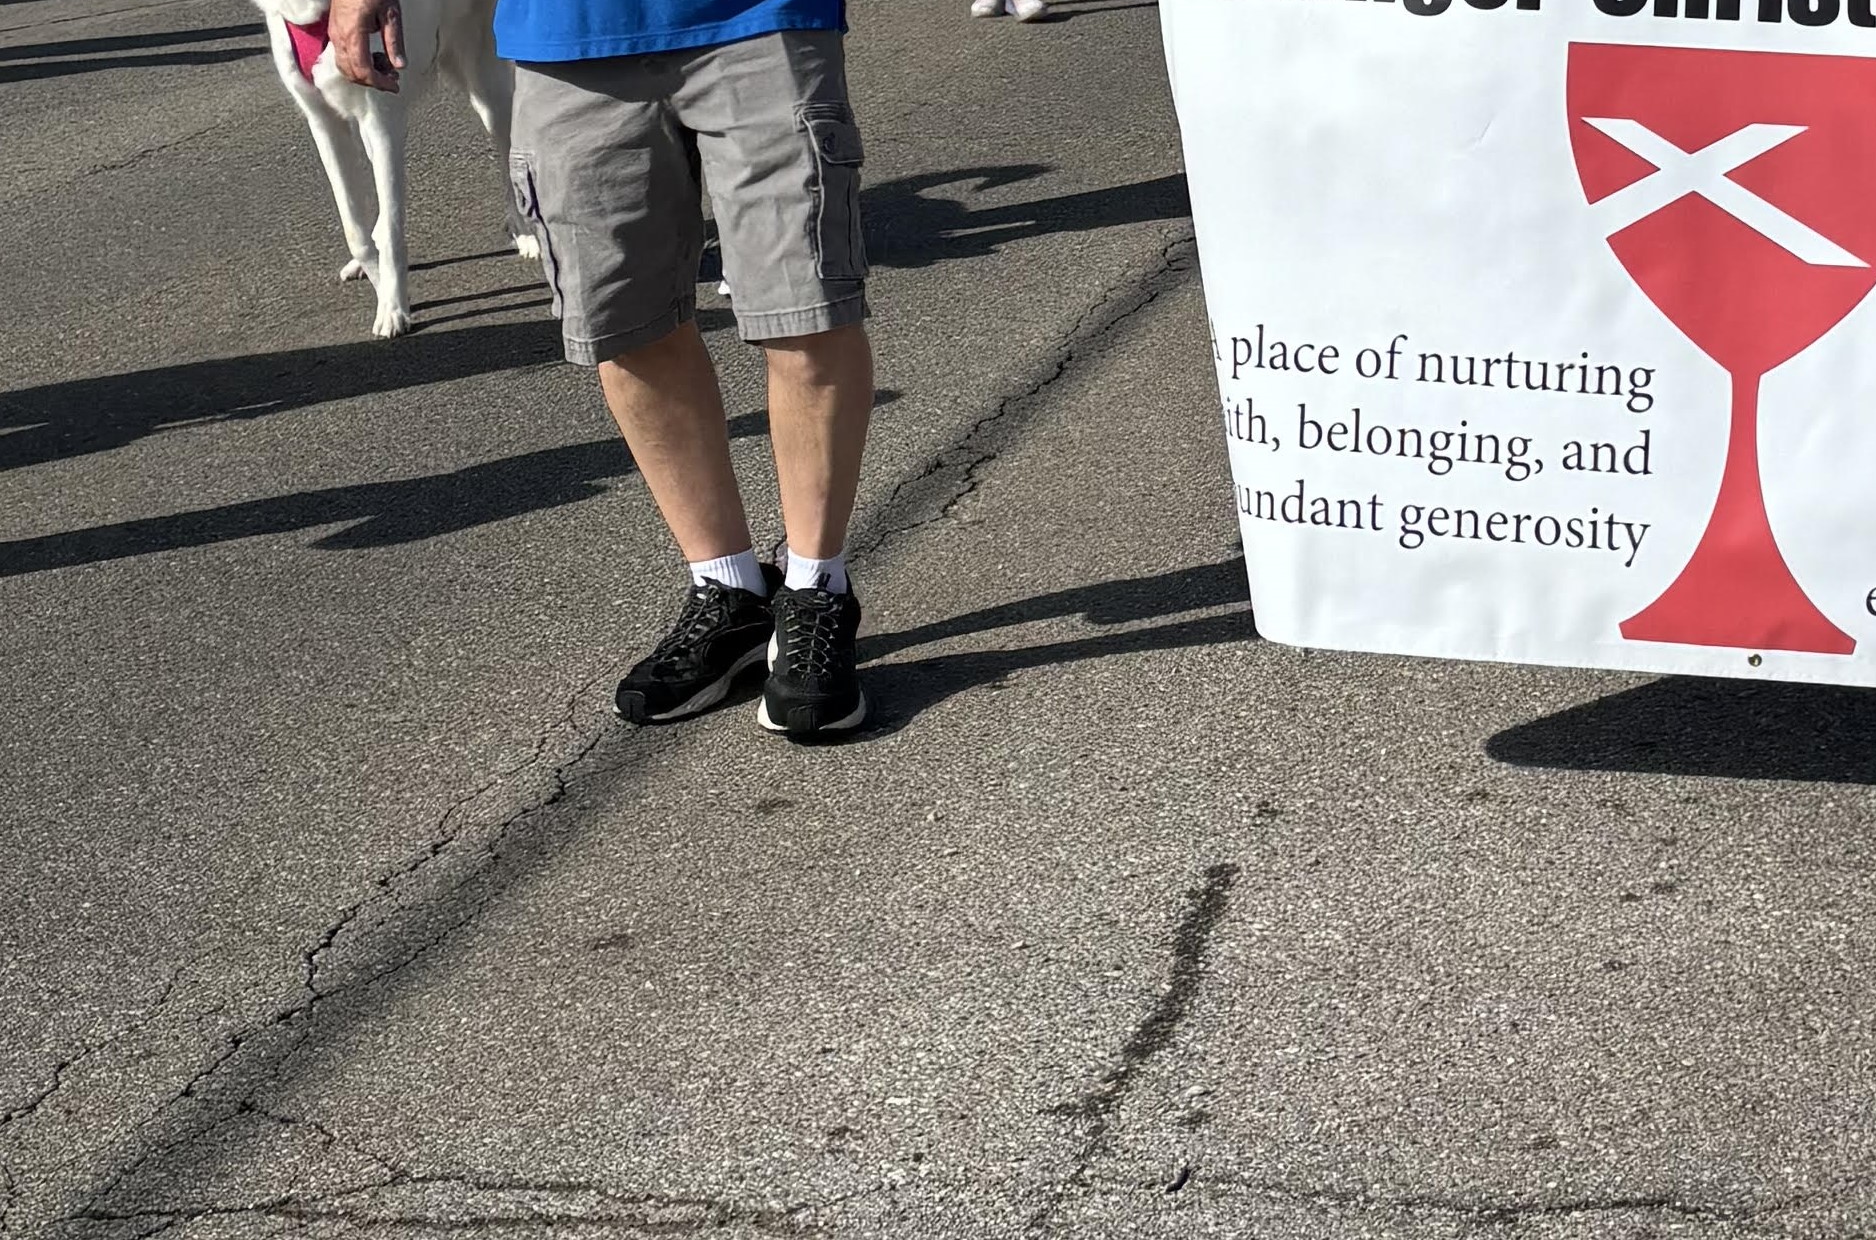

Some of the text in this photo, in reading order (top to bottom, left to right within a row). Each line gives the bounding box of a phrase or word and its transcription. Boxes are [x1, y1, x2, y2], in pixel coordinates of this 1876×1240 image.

[1231, 324, 1340, 380] place
[1355, 334, 1409, 380] of
[1416, 351, 1656, 413] nurturing
[1227, 396, 1653, 482] ith, belonging, and
[1236, 479, 1651, 568] undant generosity
